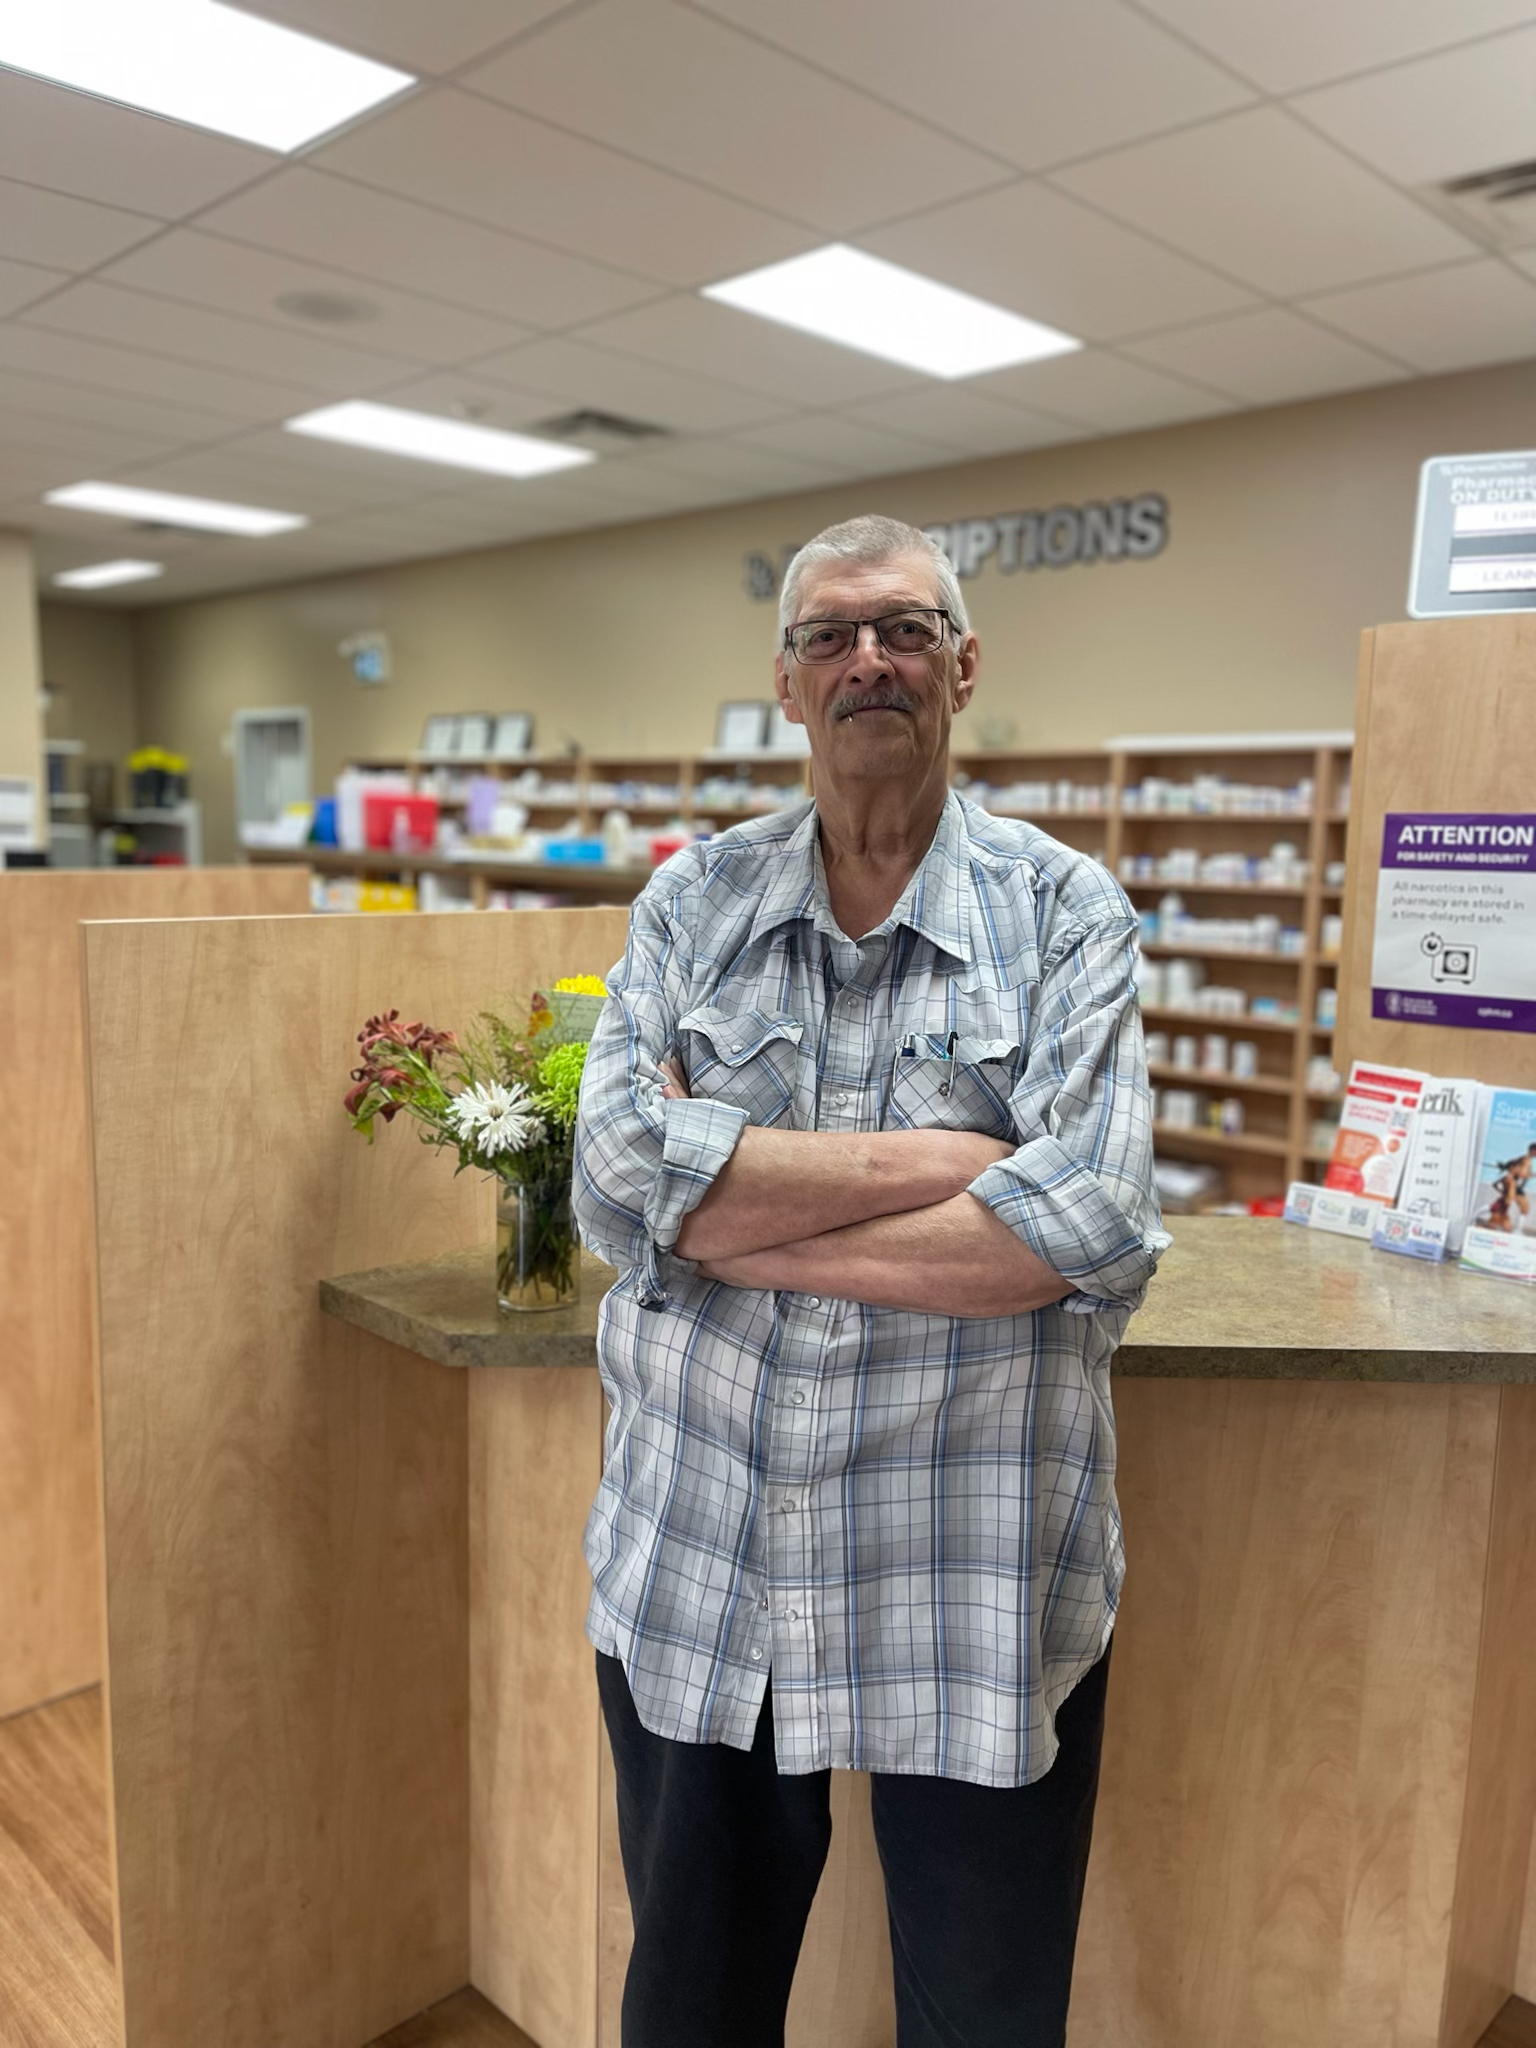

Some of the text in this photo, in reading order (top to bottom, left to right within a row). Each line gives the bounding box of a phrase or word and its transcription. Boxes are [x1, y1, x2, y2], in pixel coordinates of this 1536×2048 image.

[1450, 489, 1480, 505] ON
[1398, 825, 1534, 846] ATTENTION
[1397, 851, 1529, 864] FOR SAFETY AND SECURITY
[1394, 881, 1504, 895] All narcotics in this
[1392, 897, 1525, 910] pharmacy are stored in
[1392, 911, 1398, 919] a
[1400, 910, 1475, 924] time-delayed
